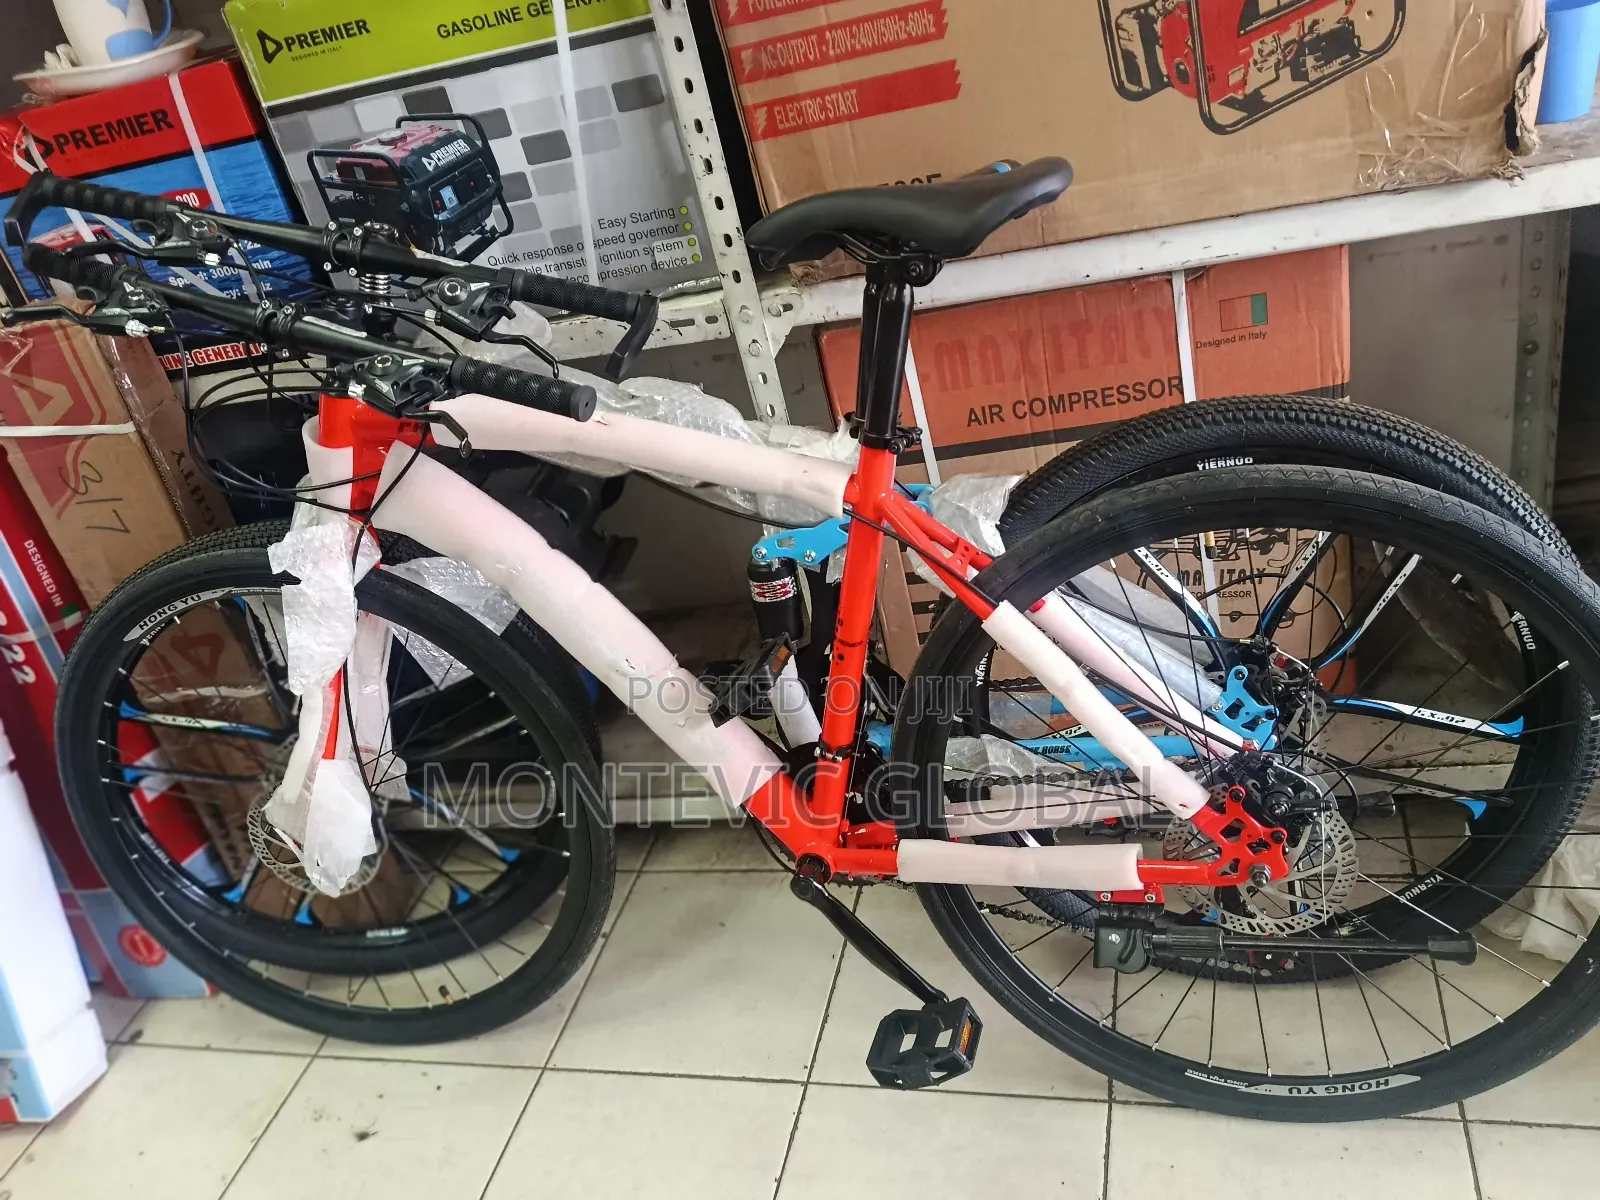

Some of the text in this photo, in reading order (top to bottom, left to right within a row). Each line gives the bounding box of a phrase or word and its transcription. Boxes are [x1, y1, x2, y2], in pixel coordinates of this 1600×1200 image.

[283, 18, 371, 52] PREMIER
[437, 6, 524, 39] GASOLINE
[761, 44, 777, 71] AC
[777, 33, 821, 68] OUTPUT
[774, 89, 860, 130] ELECTRIC START
[52, 109, 175, 155] PREMIER
[597, 207, 676, 230] Easy Starting
[487, 250, 521, 267] Quick
[523, 242, 574, 261] response
[593, 232, 626, 249] speed
[629, 223, 679, 243] governor
[599, 249, 641, 265] ignition
[643, 239, 685, 256] system
[651, 255, 688, 271] device
[1195, 330, 1267, 349] Designed in Italy
[966, 375, 1184, 427] AIR COMPRESSOR
[24, 538, 64, 608] DESIGNED IN
[138, 603, 179, 631] HONG
[179, 594, 202, 607] YU
[1287, 1085, 1318, 1095] YU
[1325, 1078, 1390, 1093] HONG
